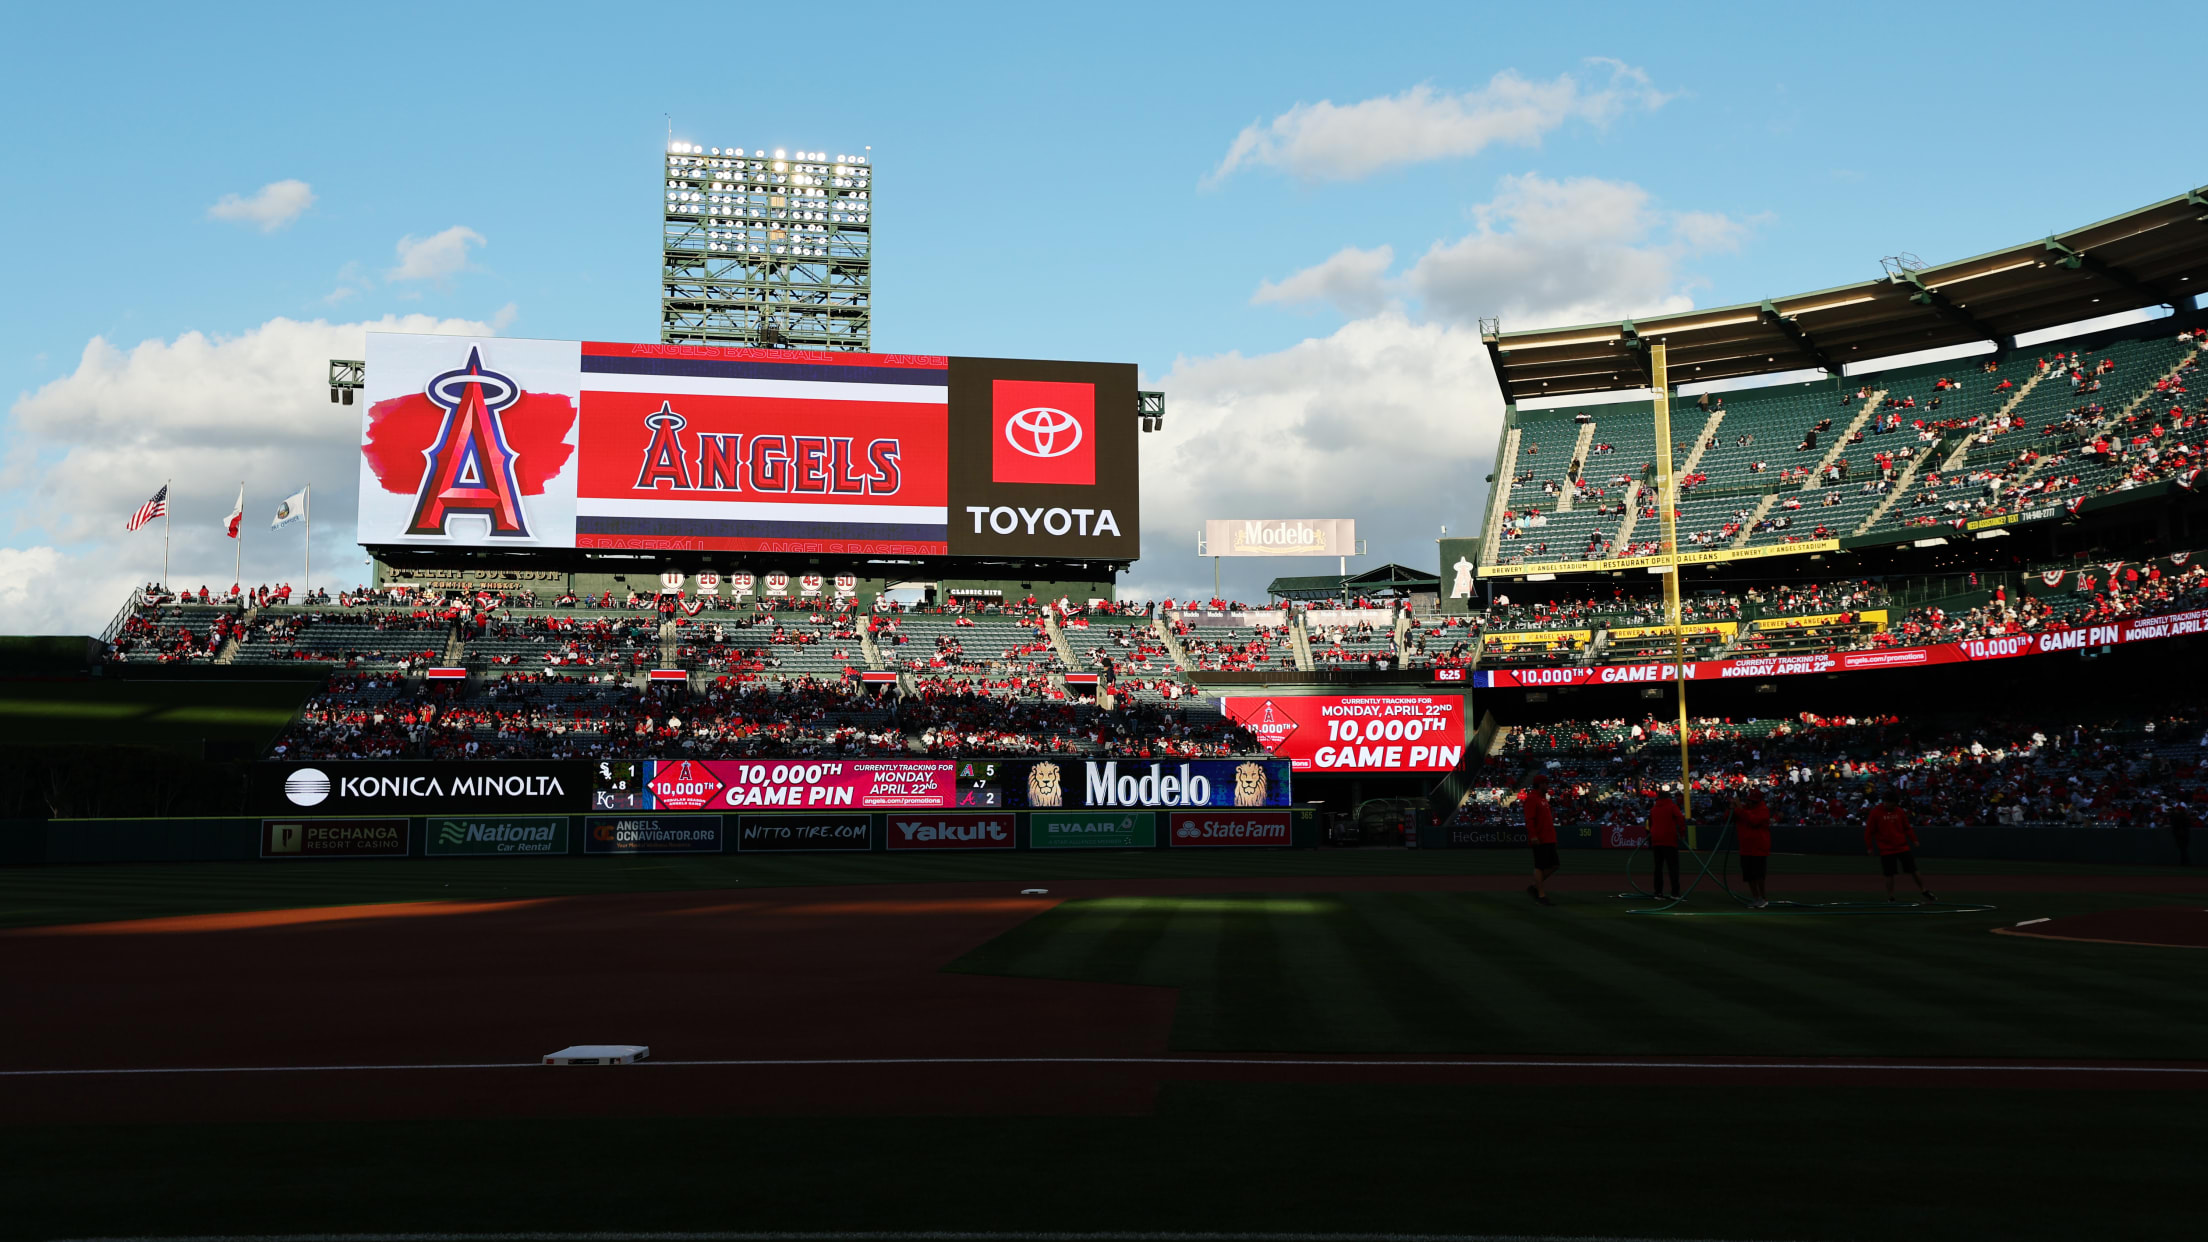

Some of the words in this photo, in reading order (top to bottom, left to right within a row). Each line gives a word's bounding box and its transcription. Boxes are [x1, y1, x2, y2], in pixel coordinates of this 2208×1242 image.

[632, 343, 720, 358] ANGELS
[723, 346, 833, 362] BASEBALL
[402, 342, 537, 542] A
[632, 400, 902, 497] ANGELS
[966, 506, 1121, 537] TOYOTA
[1244, 521, 1316, 546] Modelo
[1732, 550, 1761, 558] BREWERY
[1776, 544, 1796, 552] ANGEL
[1798, 542, 1827, 551] STADIUM
[1603, 558, 1650, 569] RESTAURANT
[1651, 557, 1671, 565] OPEN
[1684, 554, 1697, 563] ALL
[1699, 552, 1718, 561] FANS
[1492, 566, 1522, 574] BREWERY
[1537, 563, 1557, 572] ANGEL
[668, 573, 678, 584] 11
[701, 573, 716, 584] 26
[735, 573, 751, 585] 29
[769, 574, 785, 585] 30
[803, 576, 819, 586] 42
[838, 575, 853, 586] 50
[2134, 616, 2169, 628] CURRENTLY
[2170, 612, 2201, 622] TRACKING
[2125, 623, 2170, 641] MONDAY,
[2172, 619, 2202, 635] APRIL
[2039, 629, 2086, 651] GAME
[2089, 624, 2119, 645] PIN
[1970, 635, 2027, 658] 10,000TH
[1736, 658, 1777, 667] CURRENTLY
[1778, 655, 1814, 664] TRACKING
[1815, 654, 1829, 662] FOR
[1847, 652, 1924, 665] angels.com/promotions
[1440, 670, 1460, 680] 6:25
[1601, 666, 1657, 683] GAME
[1661, 664, 1696, 680] PIN
[1722, 665, 1776, 678] MONDAY,
[1777, 663, 1811, 674] APRIL
[1813, 660, 1836, 672] 22ND
[1521, 668, 1584, 686] 10,000TH
[1322, 705, 1382, 717] MONDAY,
[1384, 705, 1423, 716] APRIL
[1425, 704, 1452, 716] 22ND
[1328, 717, 1447, 745] 10,000TH
[1314, 746, 1402, 768] GAME
[1409, 745, 1462, 768] PIN
[628, 765, 634, 777] 1
[739, 763, 843, 788] 10,000TH
[986, 765, 994, 776] 5
[874, 772, 934, 783] MONDAY,
[979, 780, 986, 788] 7
[1086, 761, 1212, 807] Modelo
[340, 776, 443, 797] KONICA
[451, 776, 564, 797] MINOLTA
[619, 781, 626, 789] 8
[657, 782, 714, 797] 10,000TH
[870, 784, 908, 795] APRIL
[910, 782, 938, 795] 22ND
[627, 794, 634, 806] 1
[725, 787, 802, 806] GAME
[807, 787, 854, 806] PIN
[864, 797, 941, 805] angels.com/promotions
[986, 793, 994, 804] 2
[1300, 811, 1313, 820] 365
[616, 820, 661, 831] ANGELS.
[744, 824, 791, 839] NITTO
[796, 824, 867, 839] TIRE.COM
[896, 821, 1008, 842] Yakult
[1578, 827, 1591, 837] 350
[307, 827, 398, 840] PECHANGA
[466, 823, 556, 842] National
[616, 830, 715, 842] OCNAVIGATOR.ORG
[307, 840, 350, 848] RESORT
[357, 840, 399, 848] CASINO
[497, 843, 515, 851] Car
[518, 843, 551, 851] Rental
